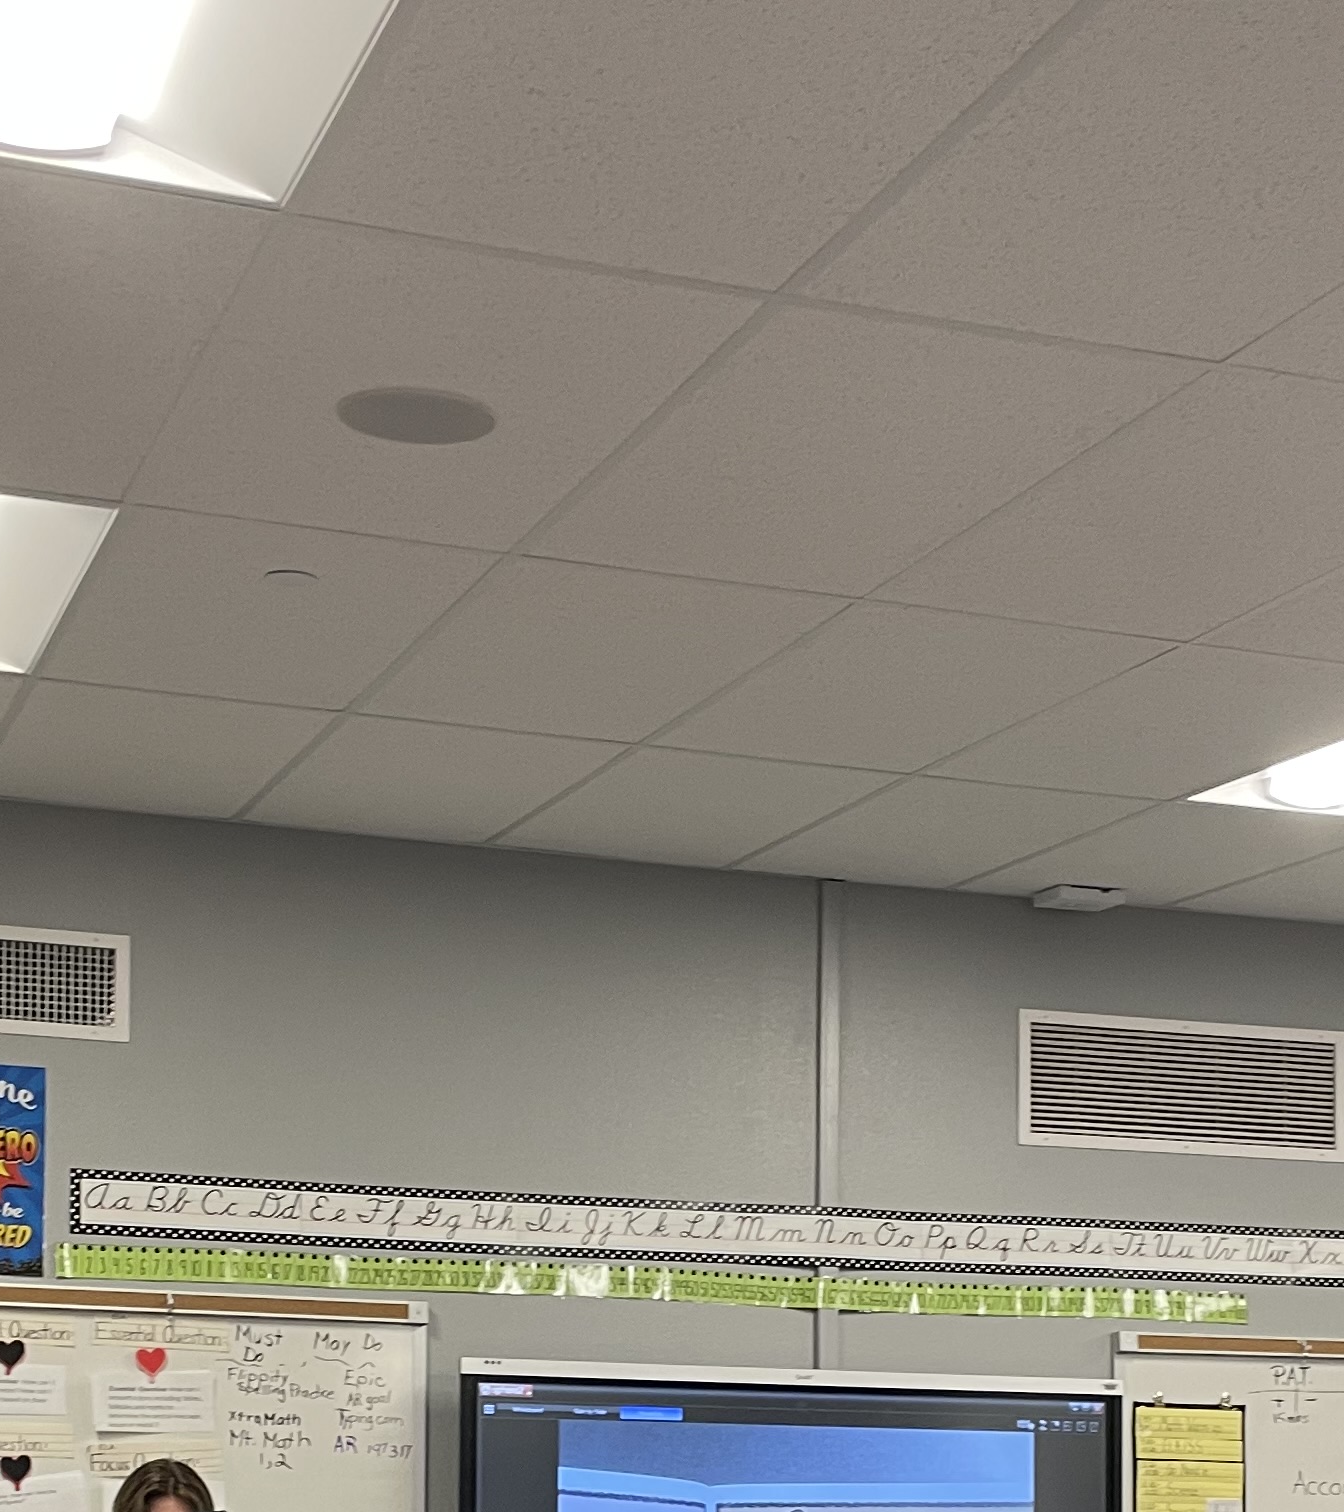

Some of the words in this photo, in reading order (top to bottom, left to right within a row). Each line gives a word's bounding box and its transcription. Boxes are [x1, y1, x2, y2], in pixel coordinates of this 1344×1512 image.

[2, 1202, 25, 1218] be
[84, 1183, 133, 1211] Aa
[145, 1185, 192, 1213] Bb
[201, 1188, 238, 1216] Cc
[248, 1191, 301, 1219] Dd
[309, 1195, 347, 1222] Ee
[356, 1197, 405, 1237] Ff
[412, 1201, 462, 1240] Gg
[472, 1204, 516, 1231] Hh
[581, 1209, 615, 1246] Jj
[622, 1211, 671, 1238] Kk
[679, 1213, 726, 1240] Ll
[734, 1215, 806, 1242] Mm
[814, 1218, 867, 1246] Nn
[874, 1221, 915, 1249] Oo
[923, 1224, 958, 1260] Pp
[966, 1226, 1011, 1262] Qq
[1019, 1227, 1058, 1254] Rr
[1113, 1232, 1146, 1257] Tt
[1155, 1233, 1196, 1259] Uu
[1205, 1235, 1241, 1260] Vv
[1246, 1238, 1291, 1263] Ww
[1300, 1240, 1343, 1265] Xx
[95, 1321, 155, 1341] Essential
[235, 1325, 283, 1346] Must
[313, 1331, 351, 1356] May
[363, 1333, 384, 1351] Do
[243, 1346, 264, 1362] Do
[343, 1369, 386, 1388] Epic
[263, 1430, 312, 1450] Math
